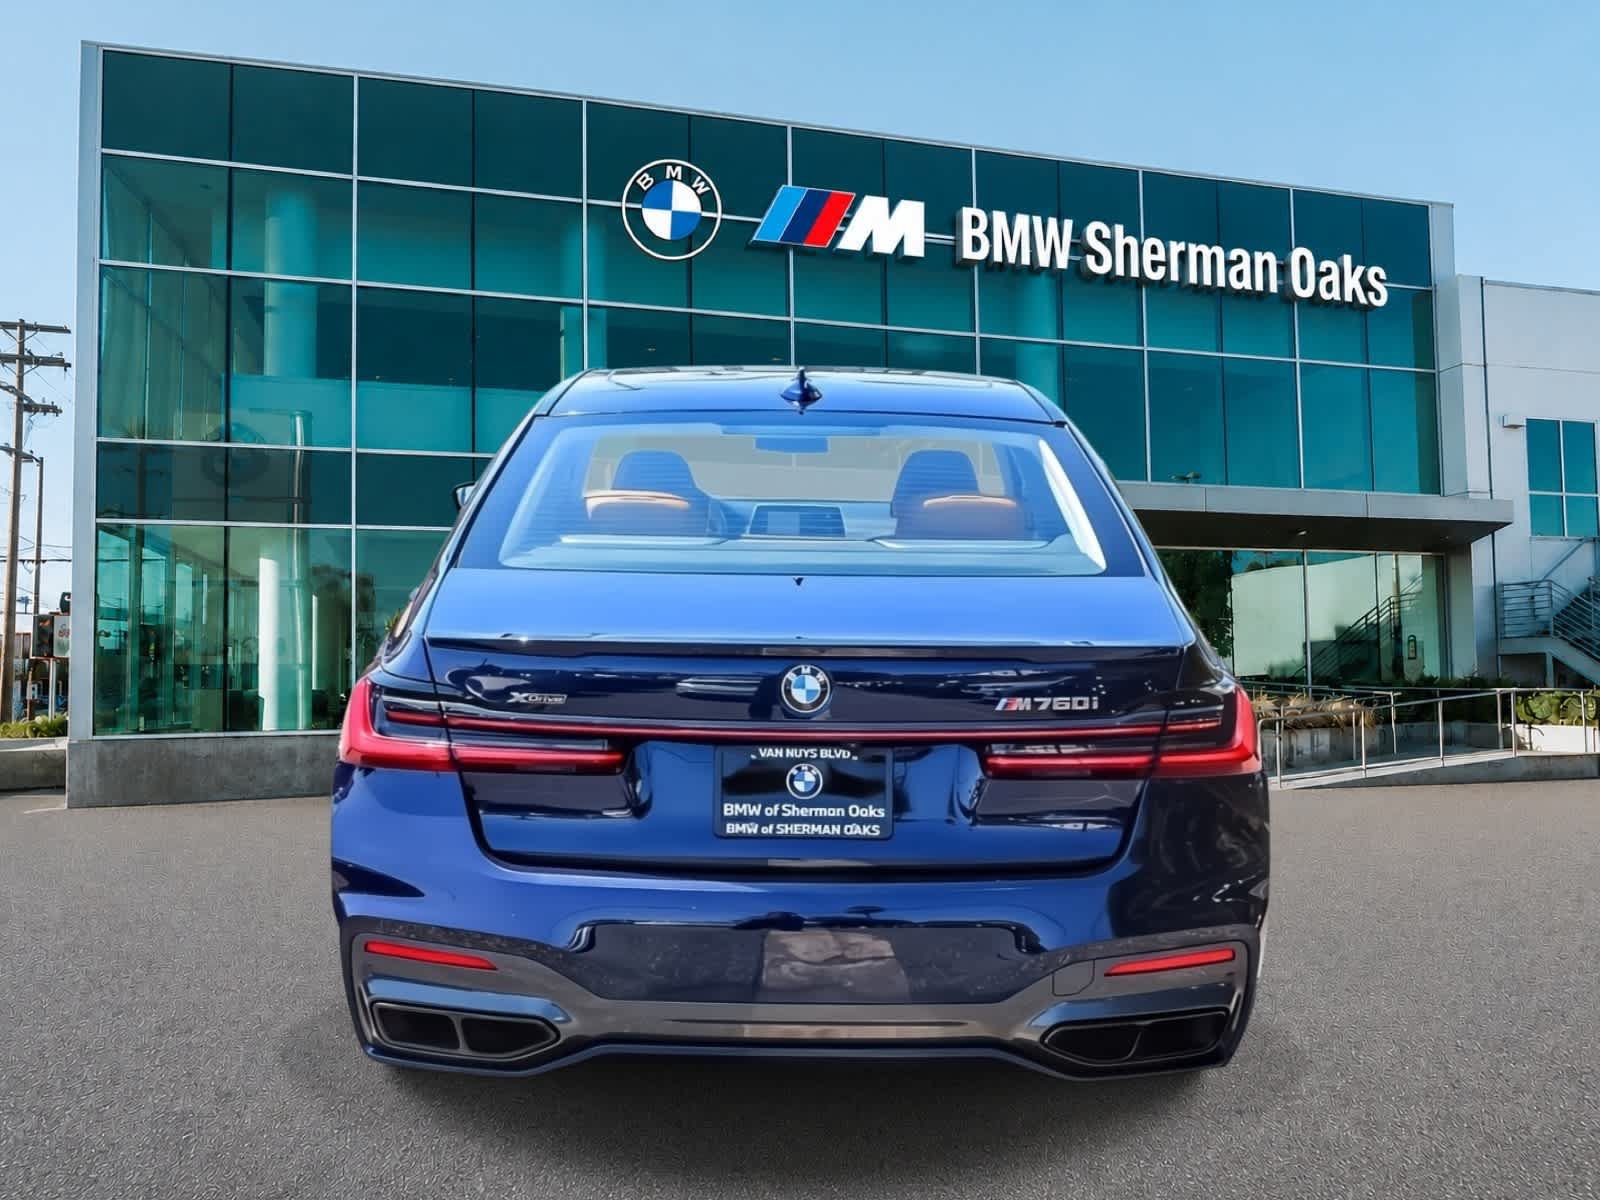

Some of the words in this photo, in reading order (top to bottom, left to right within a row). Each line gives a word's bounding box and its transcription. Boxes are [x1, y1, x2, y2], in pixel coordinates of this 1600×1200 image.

[636, 165, 711, 195] BMW
[960, 206, 1073, 270] BMW
[1083, 221, 1279, 293] Sherman
[1290, 247, 1389, 307] Oaks
[759, 747, 783, 758] VAN
[785, 748, 817, 758] NUYS
[820, 748, 851, 759] BLVD
[723, 803, 762, 816] BMW
[764, 804, 779, 816] of
[782, 804, 845, 817] Sherman
[849, 805, 885, 817] Oaks
[726, 823, 759, 834] BMW
[761, 823, 773, 834] of
[776, 824, 840, 835] SHERMAN
[844, 824, 880, 836] OAKS
